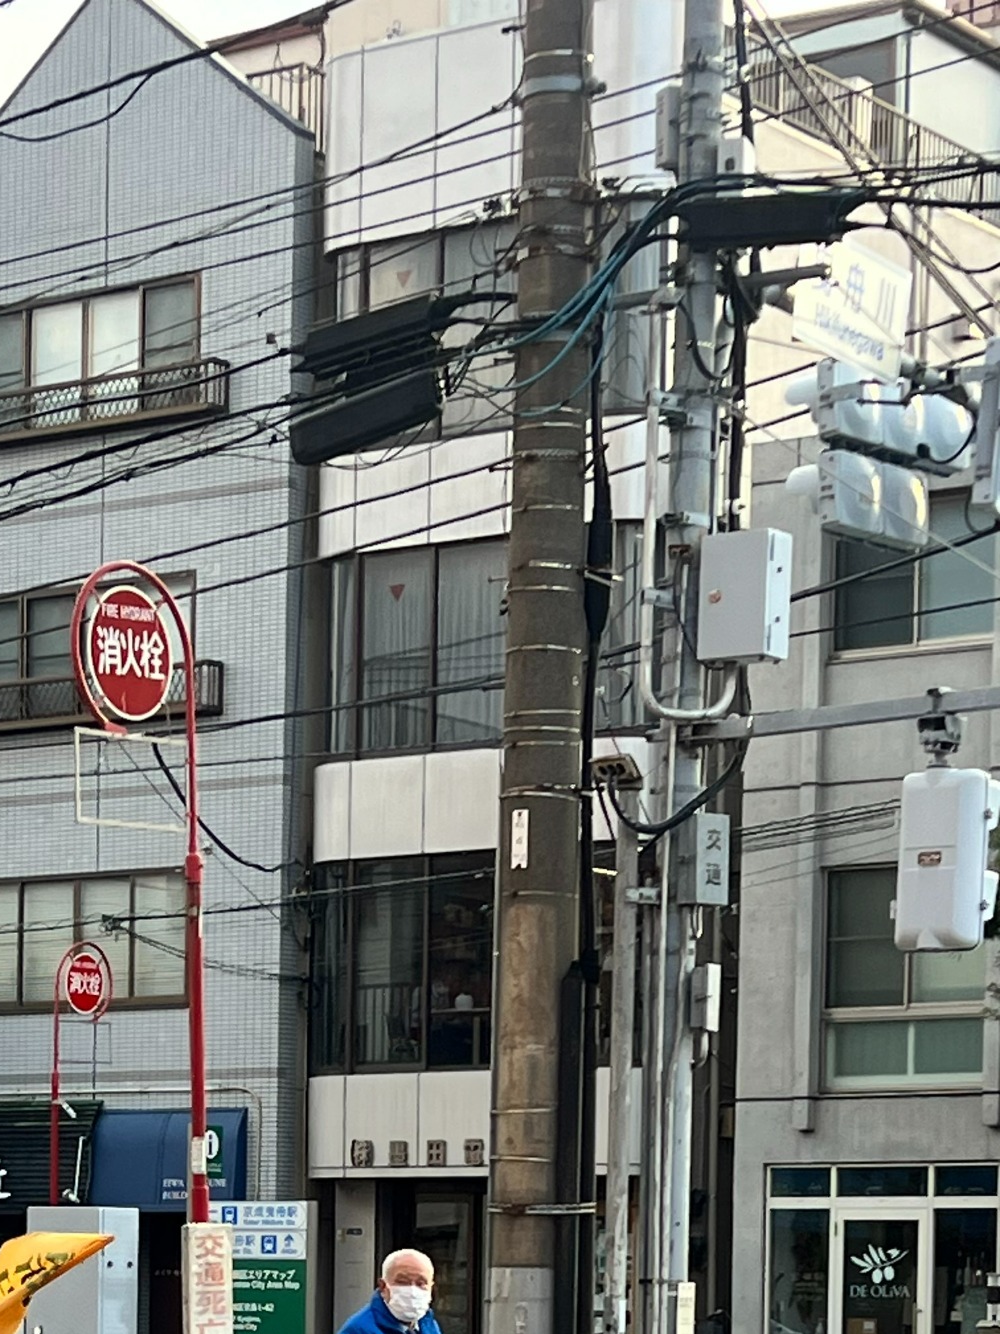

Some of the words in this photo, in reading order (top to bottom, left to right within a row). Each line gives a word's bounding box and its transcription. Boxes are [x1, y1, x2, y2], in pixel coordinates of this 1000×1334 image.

[96, 625, 166, 680] 消火栓
[849, 1284, 868, 1298] DE
